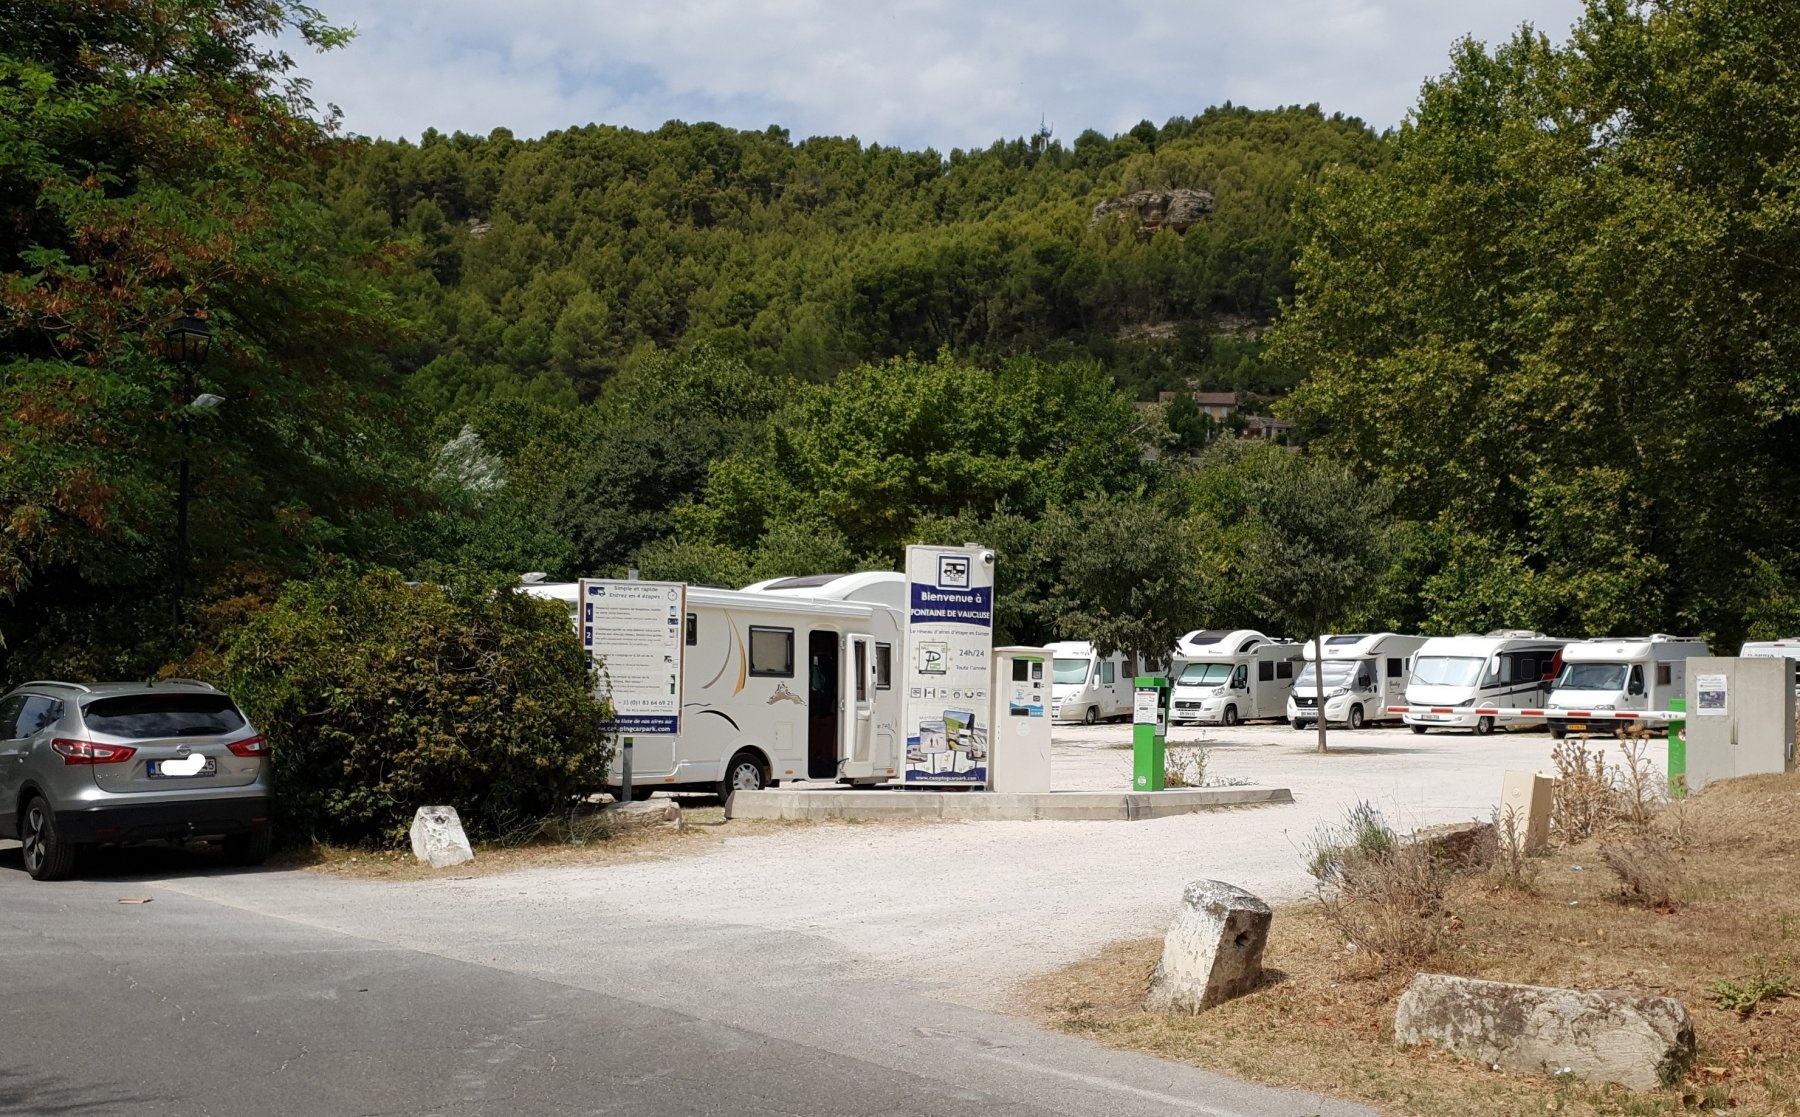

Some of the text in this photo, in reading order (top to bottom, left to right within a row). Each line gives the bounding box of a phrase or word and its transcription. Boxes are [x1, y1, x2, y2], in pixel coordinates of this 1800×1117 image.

[921, 592, 982, 603] Bienvenue à
[911, 608, 991, 619] FONTAINE DE VAUCLUSE
[959, 649, 985, 657] 24h/24
